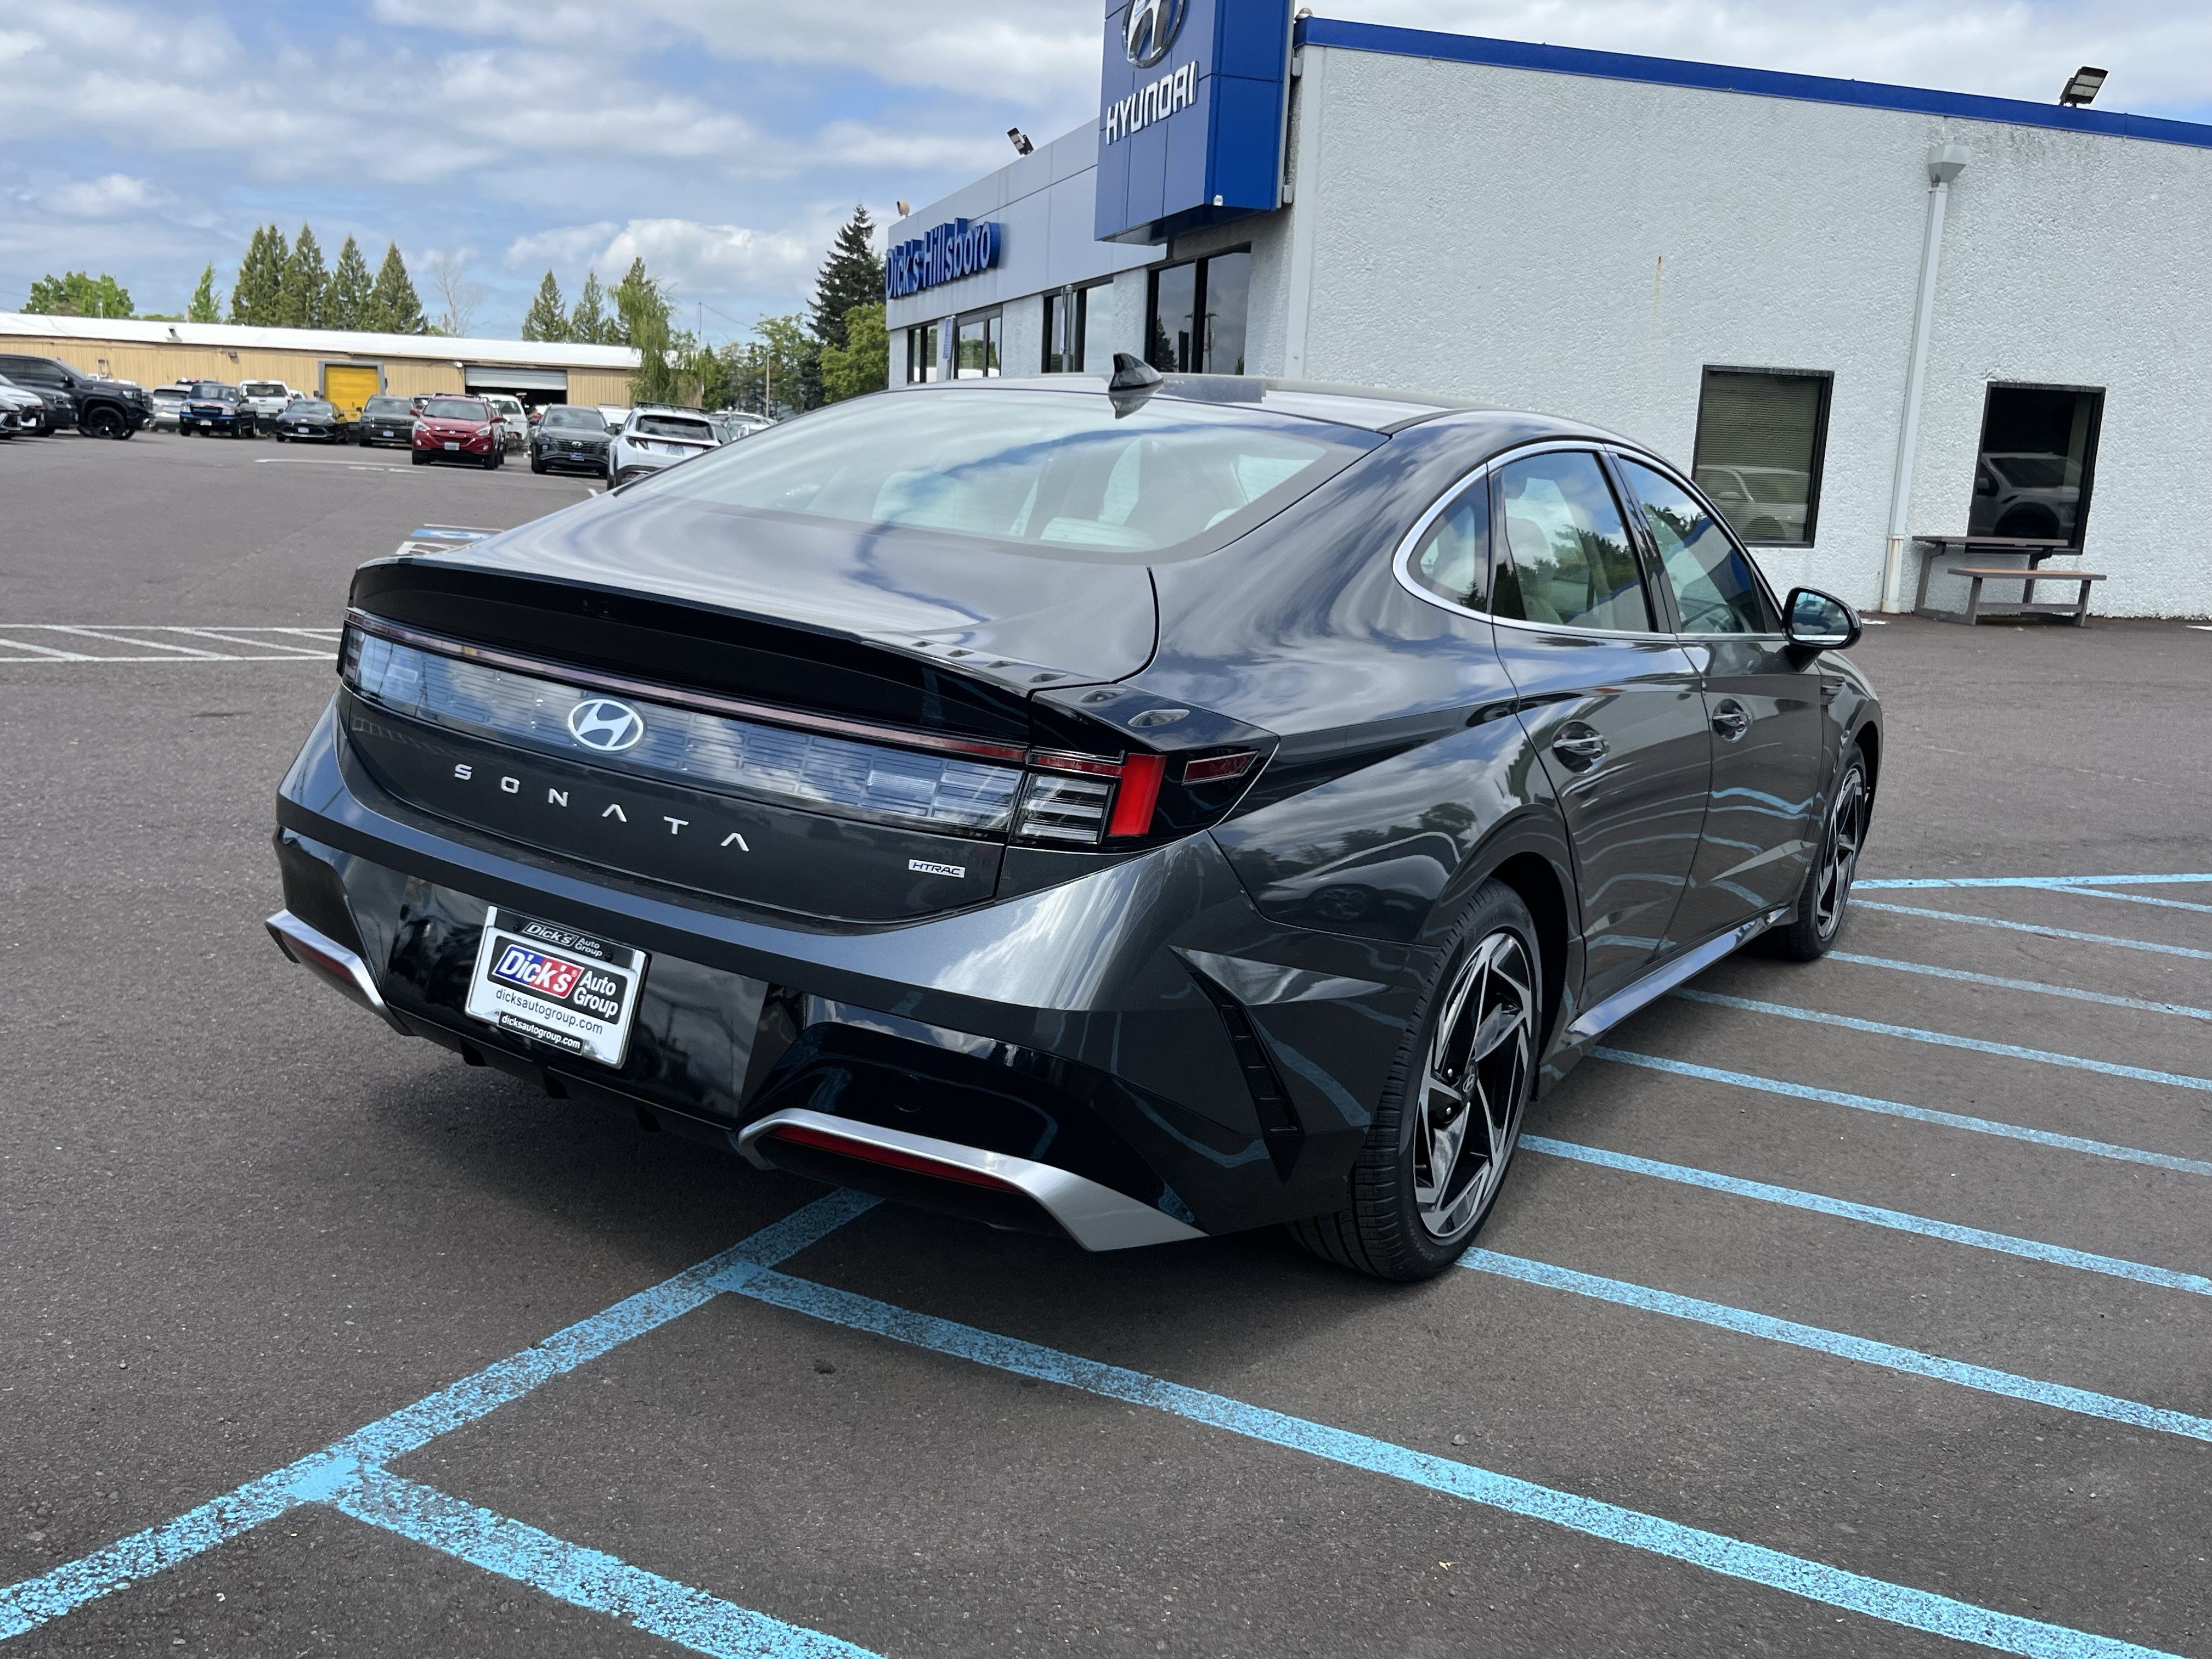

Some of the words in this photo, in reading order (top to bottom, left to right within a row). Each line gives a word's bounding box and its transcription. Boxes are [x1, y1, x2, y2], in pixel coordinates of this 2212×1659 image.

[1106, 60, 1199, 145] HYUNDAI
[885, 240, 920, 300] Dick's
[923, 218, 992, 288] Hillsboro
[454, 763, 749, 852] SONATA
[912, 862, 961, 876] HTRAC
[574, 943, 603, 957] Group
[579, 938, 601, 949] Auto
[579, 970, 617, 996] Auto
[496, 988, 603, 1035] dicksautogroup.com
[573, 988, 619, 1018] Group
[501, 1014, 581, 1050] dicksautogroup.com
